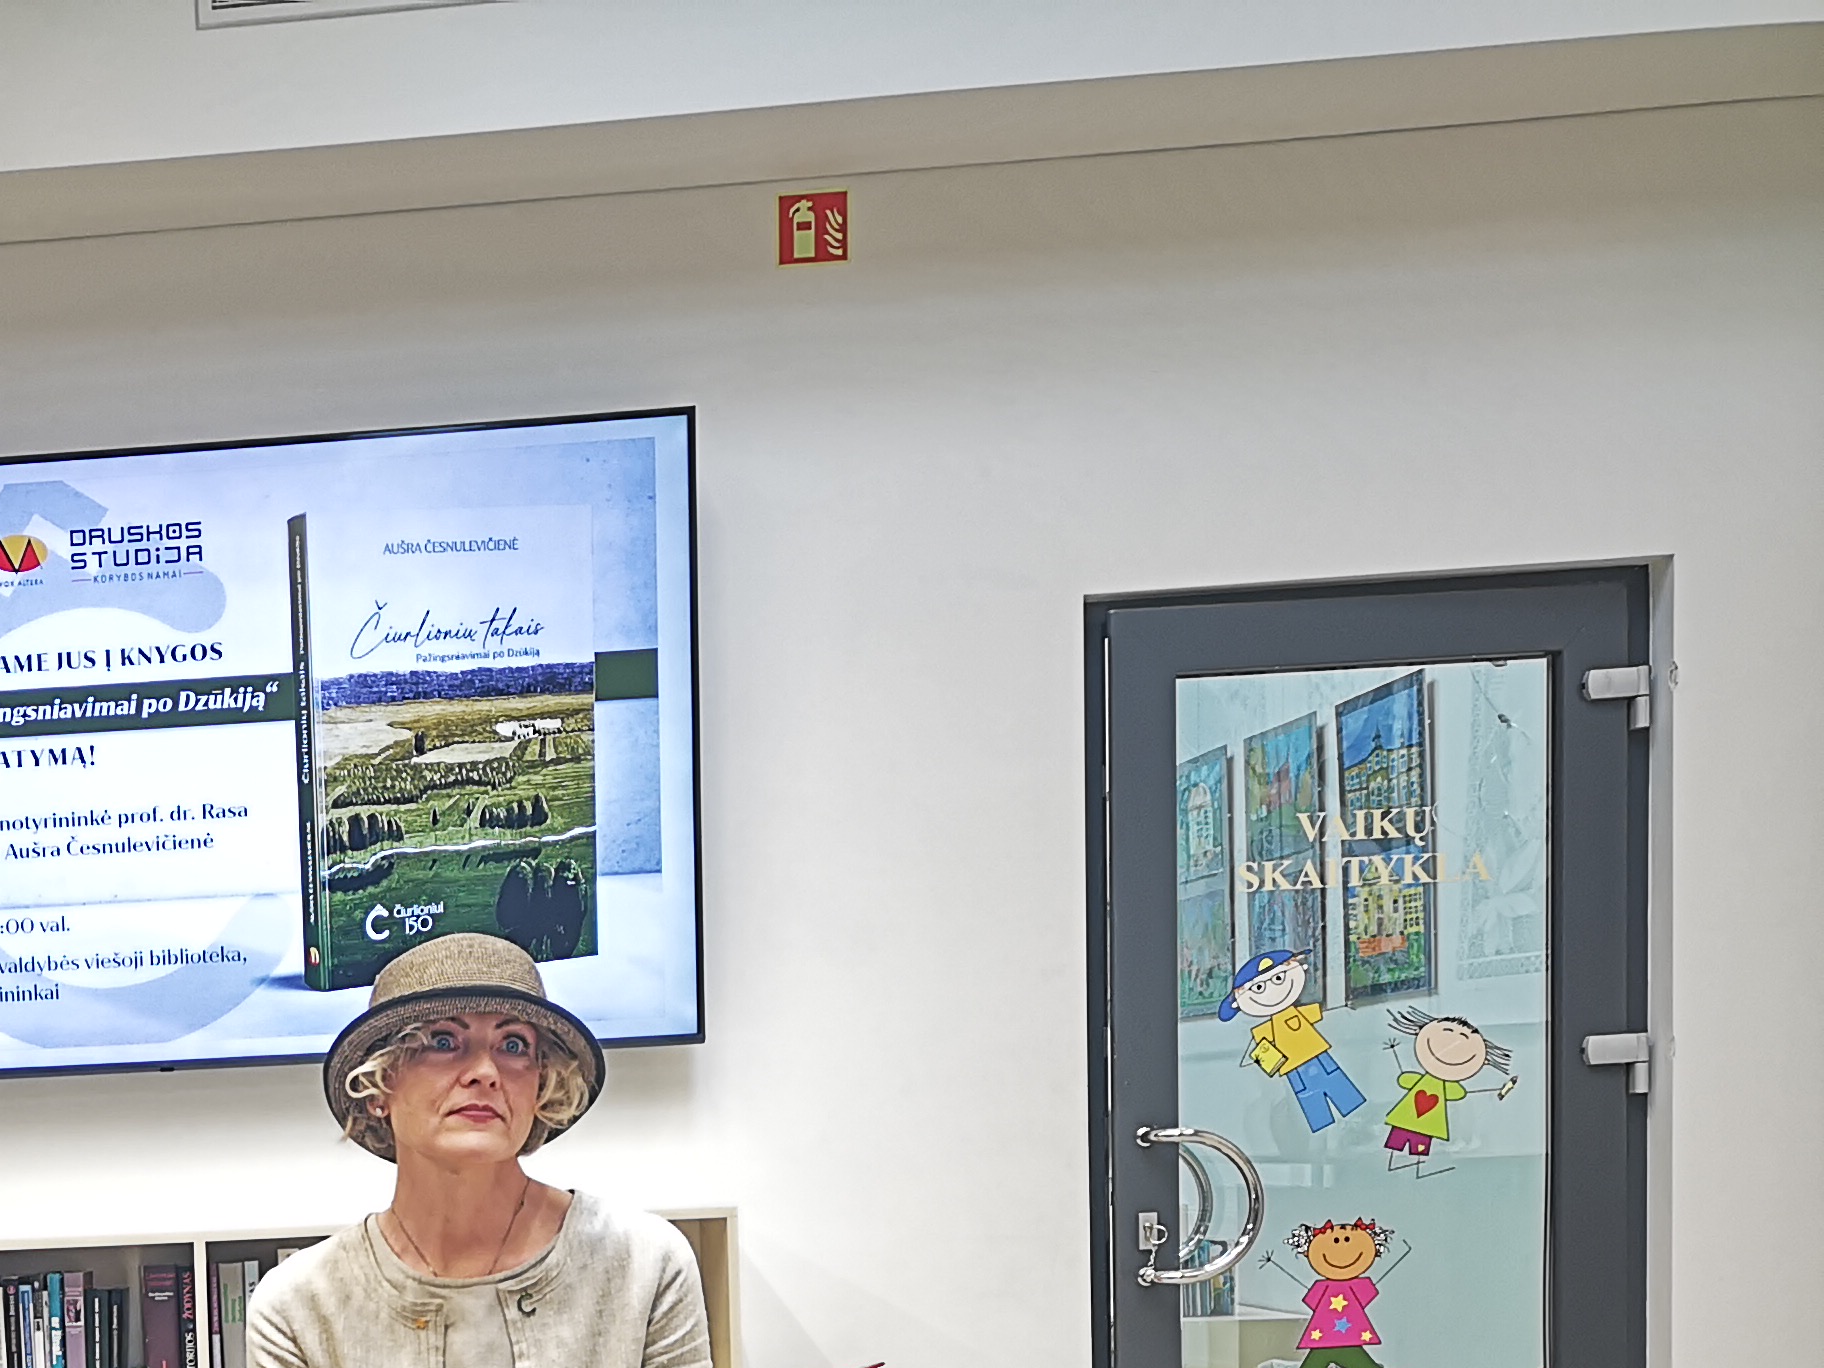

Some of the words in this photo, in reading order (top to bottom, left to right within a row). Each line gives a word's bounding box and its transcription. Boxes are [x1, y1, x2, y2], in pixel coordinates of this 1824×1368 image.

[383, 538, 422, 555] AUŠRA
[424, 536, 519, 553] ČESNULEVIČIENĖ
[17, 578, 44, 587] ALTERA
[93, 571, 144, 584] KORYBOS
[147, 569, 183, 580] NAMAI
[350, 599, 477, 660] Čiurlionių
[480, 606, 545, 649] takais
[56, 648, 96, 671] JUS
[104, 648, 112, 672] Į
[119, 641, 224, 667] KNYGOS
[492, 651, 505, 661] po
[142, 693, 173, 717] po
[117, 804, 164, 827] prof.
[169, 804, 196, 823] dr.
[201, 802, 249, 821] Rasa
[1295, 805, 1433, 847] VAIKŲ
[4, 841, 61, 861] Aušra
[66, 834, 215, 858] Česnulevičienė
[1237, 852, 1493, 893] SKAITYKLA
[39, 915, 71, 934] val.
[404, 915, 433, 936] 150
[84, 950, 145, 973] viešoji
[149, 945, 248, 968] biblioteka,
[182, 1271, 194, 1320] ŽODYNAS
